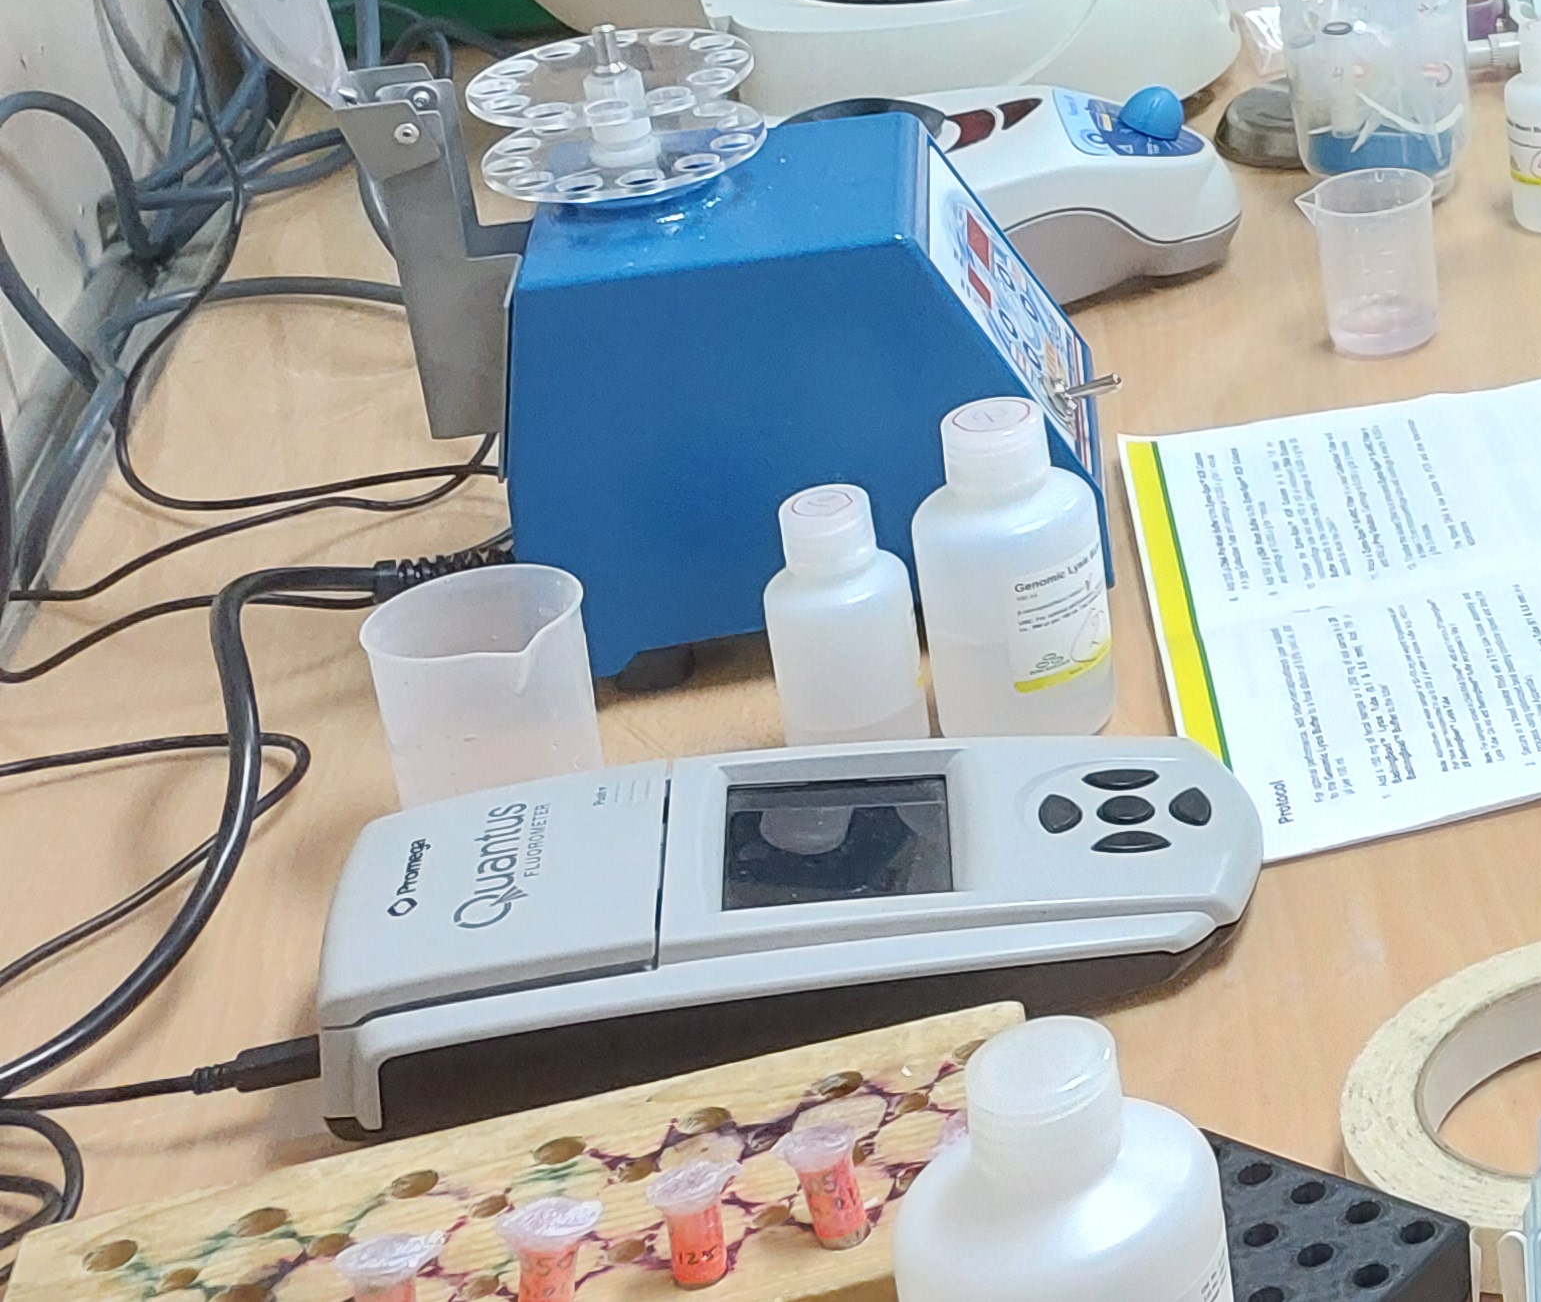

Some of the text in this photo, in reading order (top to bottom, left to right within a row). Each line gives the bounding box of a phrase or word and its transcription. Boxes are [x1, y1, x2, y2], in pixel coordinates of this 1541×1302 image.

[1014, 570, 1066, 594] Genomic
[1067, 556, 1089, 575] Lysis
[1268, 778, 1294, 825] Protocol
[395, 837, 432, 897] Promega
[452, 801, 530, 930] Quantus
[523, 802, 551, 879] FLUOROMETER
